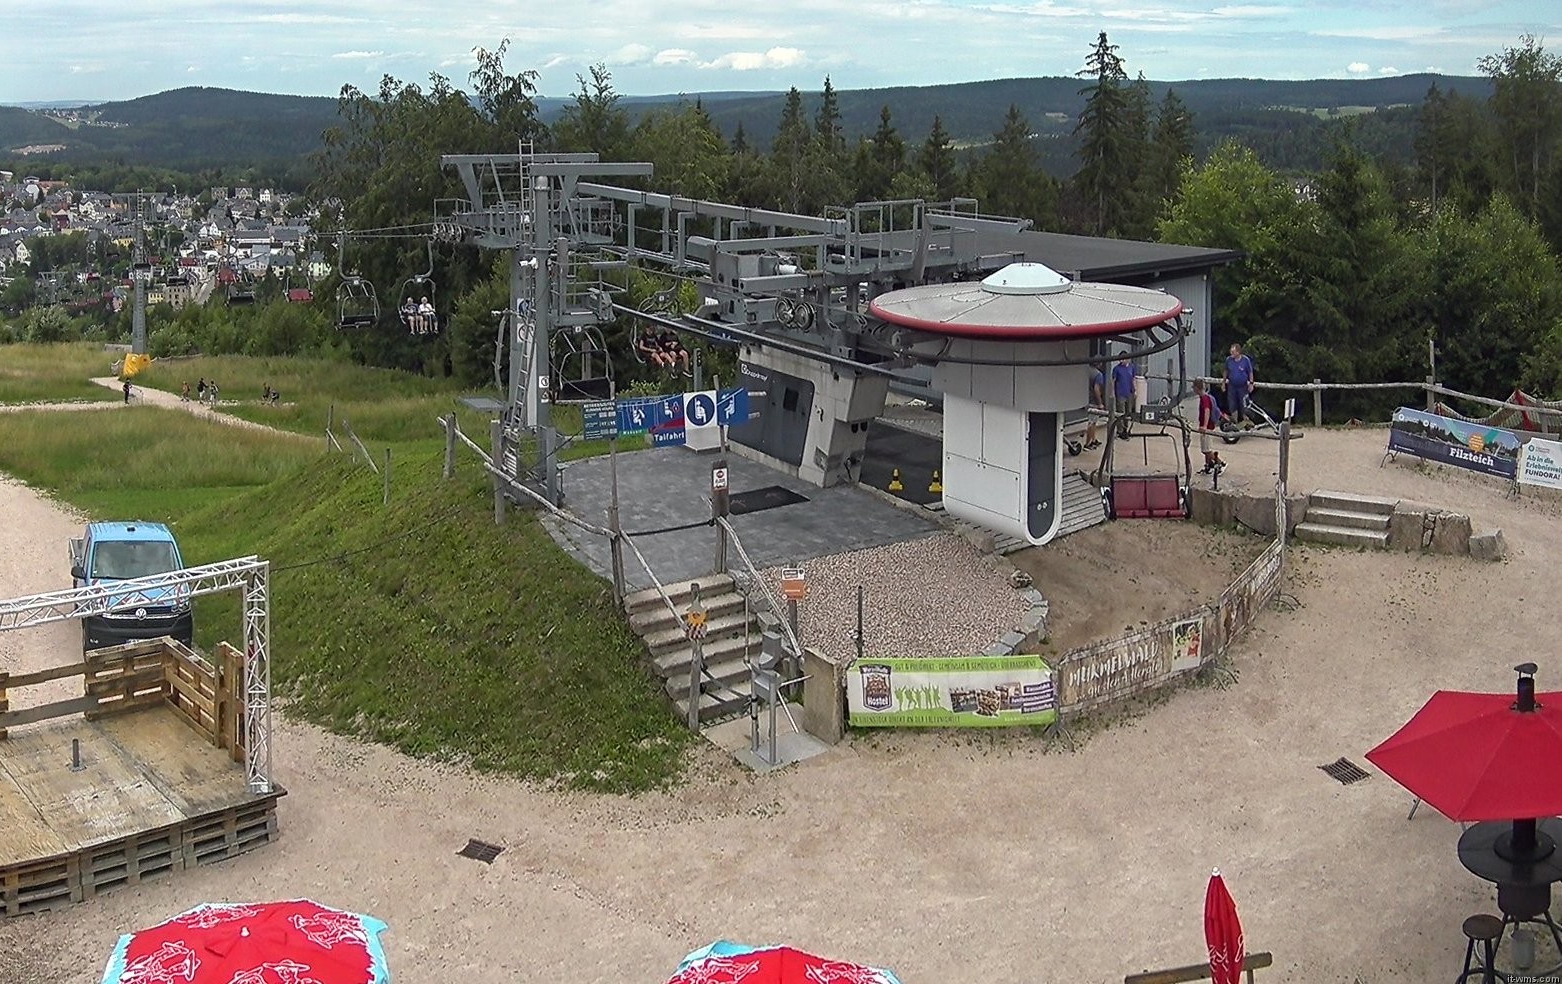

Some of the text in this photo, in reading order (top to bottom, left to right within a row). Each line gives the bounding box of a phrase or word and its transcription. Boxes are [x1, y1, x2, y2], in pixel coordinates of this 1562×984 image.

[654, 432, 685, 441] Talfahrt
[1449, 447, 1495, 467] Filzteich
[1544, 457, 1554, 465] die
[1525, 469, 1561, 480] FUNDORA!
[1069, 640, 1159, 687] MURMELWALD
